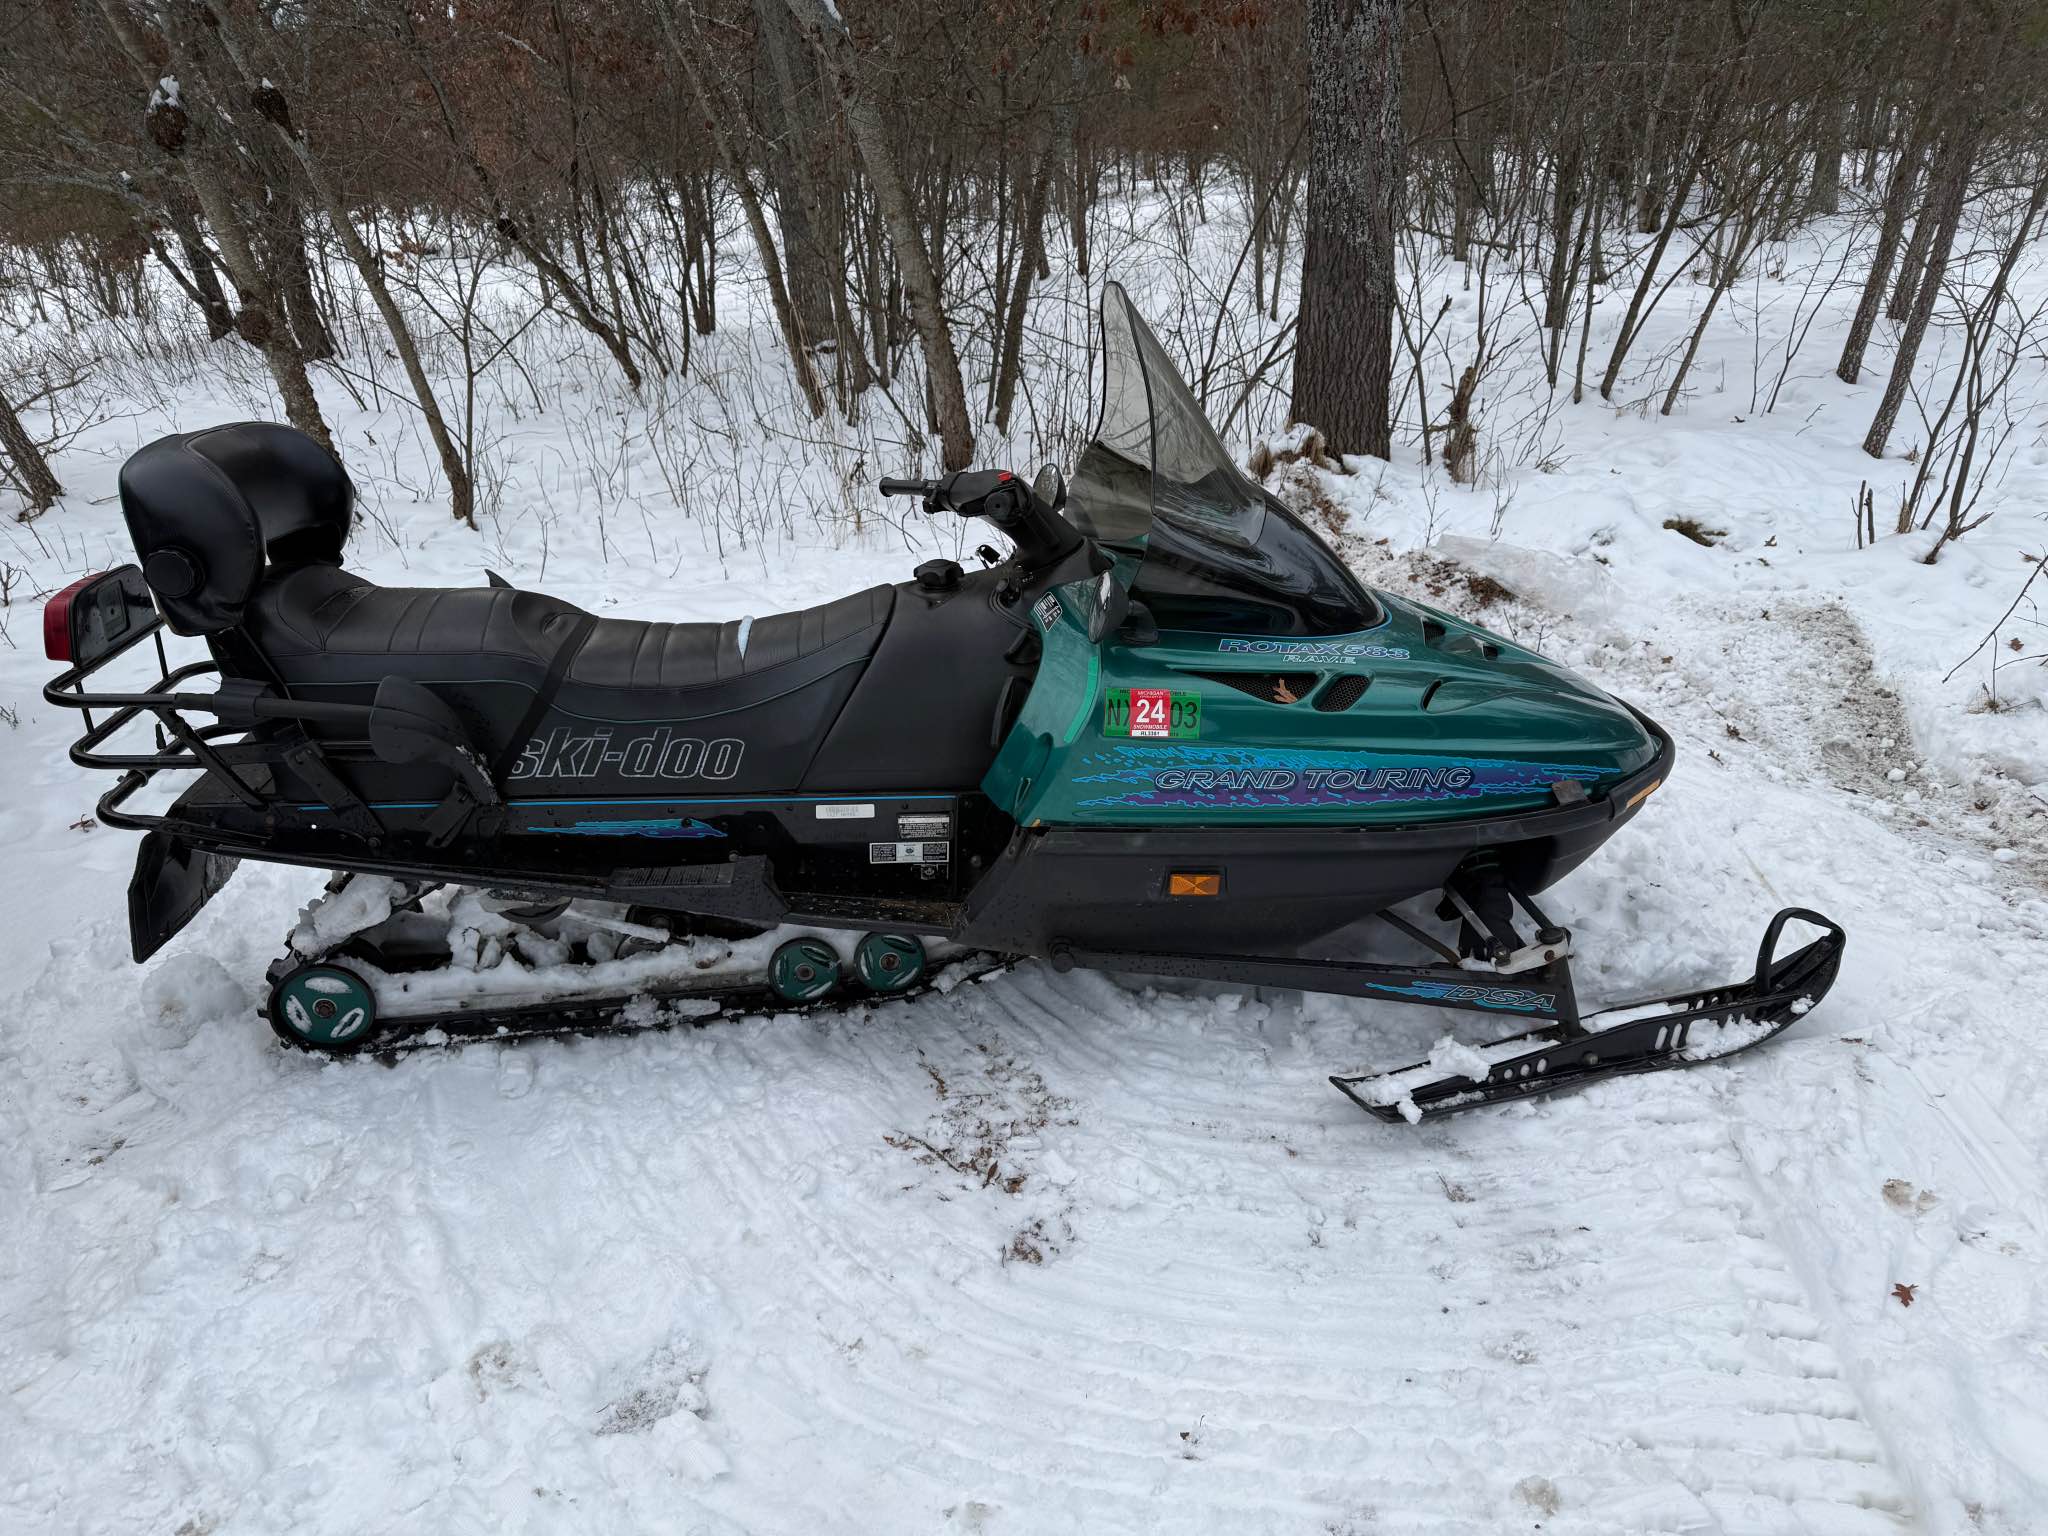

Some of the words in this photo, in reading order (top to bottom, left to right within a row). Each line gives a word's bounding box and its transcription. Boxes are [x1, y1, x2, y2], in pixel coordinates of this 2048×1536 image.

[1218, 638, 1342, 656] ROTAX
[1343, 644, 1410, 660] 583
[1136, 698, 1166, 723] 24
[1154, 768, 1297, 791] GRAND
[1304, 766, 1474, 790] TOURING
[1443, 985, 1556, 1009] DSA
